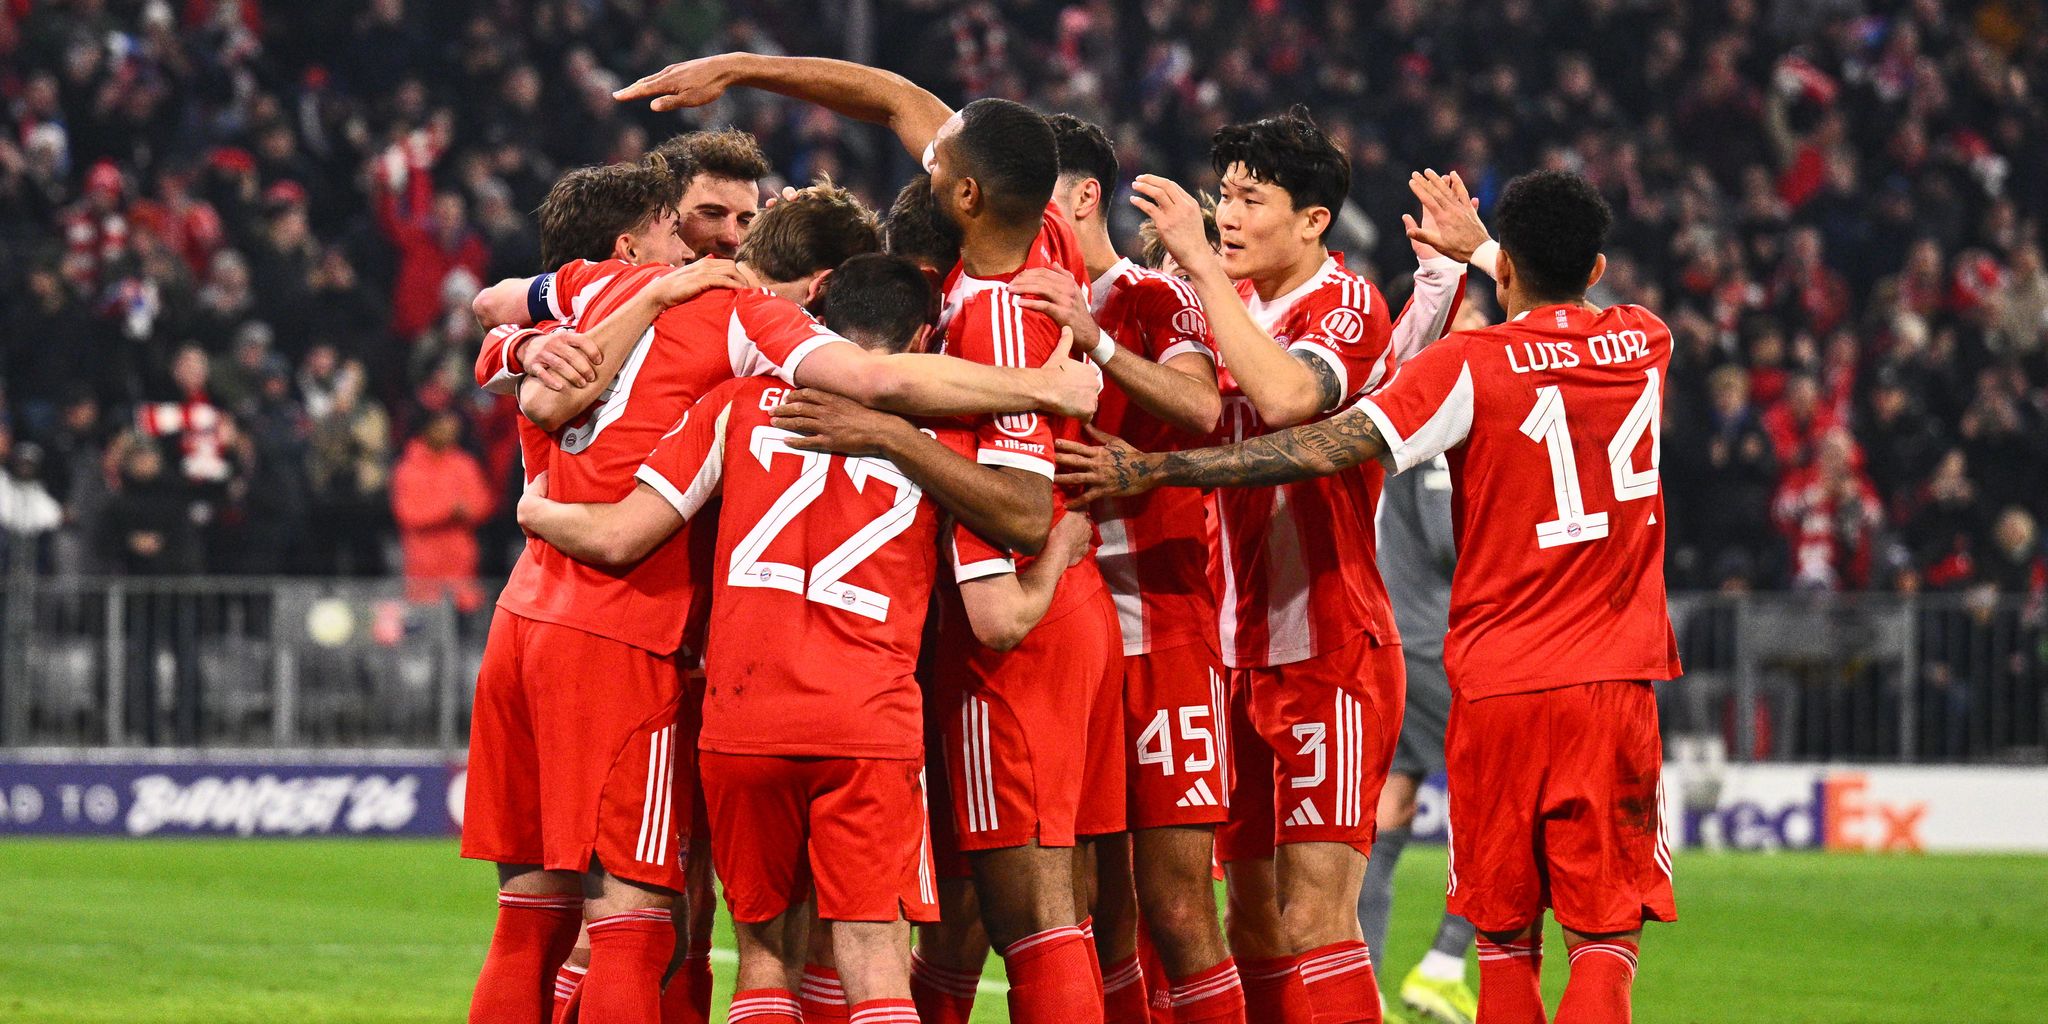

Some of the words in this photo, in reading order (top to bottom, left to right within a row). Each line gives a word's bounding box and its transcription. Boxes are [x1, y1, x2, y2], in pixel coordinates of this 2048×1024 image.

[1504, 342, 1580, 374] LUIS
[994, 439, 1046, 455] Allianz
[1518, 367, 1660, 549] 14
[727, 425, 923, 623] 22
[1136, 704, 1215, 777] 45
[1291, 722, 1326, 789] 3
[57, 784, 119, 825] TO
